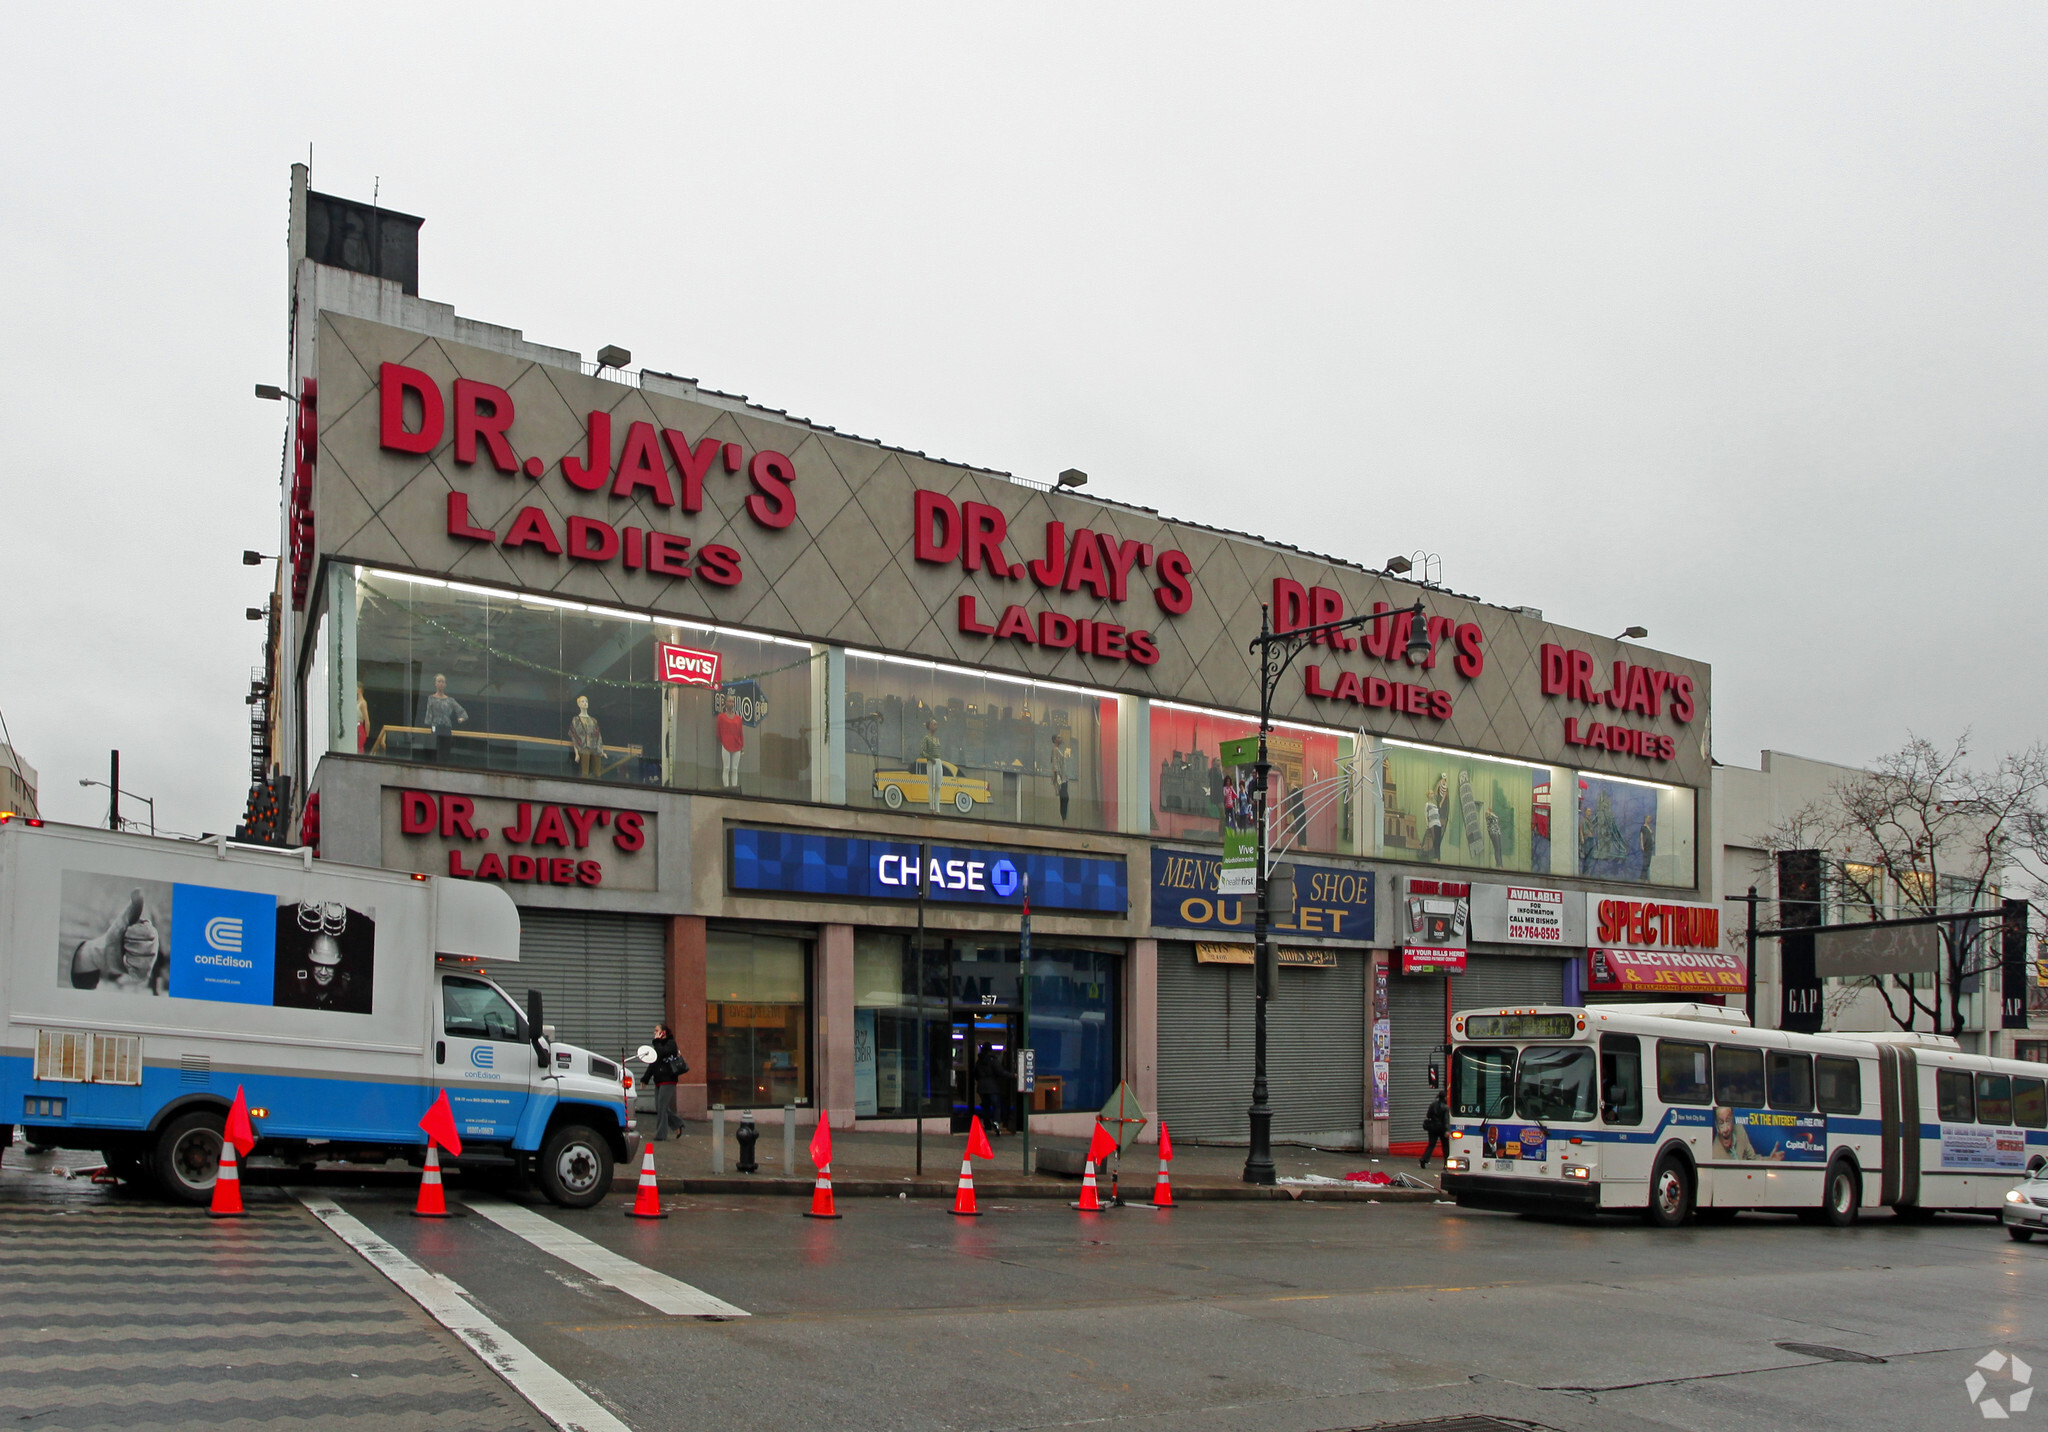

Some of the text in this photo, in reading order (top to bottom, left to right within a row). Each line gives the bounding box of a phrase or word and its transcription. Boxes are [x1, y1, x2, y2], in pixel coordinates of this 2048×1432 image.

[379, 361, 796, 529] DR. JAY'S
[447, 491, 742, 585] LADIES
[914, 489, 1192, 614] DR. JAY'S
[958, 595, 1160, 665] LADIES
[1273, 577, 1483, 678] DR. JAY'S
[1305, 665, 1453, 719] LADIES
[1541, 643, 1694, 723] DR. JAY'S
[1565, 717, 1675, 760] LADIES
[401, 791, 645, 851] DR. JAY'S
[450, 850, 602, 885] LADIES
[1238, 845, 1254, 855] Vive
[879, 855, 985, 891] CHASE
[1160, 857, 1222, 891] MEN'S
[1310, 873, 1368, 904] SHOE
[1511, 889, 1561, 903] AVAILABLE
[1180, 897, 1349, 933] OUET
[1597, 899, 1719, 948] SPECTRUM
[194, 955, 253, 969] conEdison
[1612, 950, 1737, 968] ELECTRONICS
[1625, 969, 1642, 982] &
[981, 995, 997, 1005] 257
[1789, 988, 1817, 1013] GAP
[2001, 998, 2021, 1016] AP
[464, 1071, 501, 1079] conEdison
[1735, 1116, 1749, 1124] WANT
[1749, 1113, 1759, 1125] 5X
[1760, 1114, 1772, 1125] THE
[1772, 1115, 1797, 1126] INTEREST
[1804, 1118, 1813, 1127] FREE
